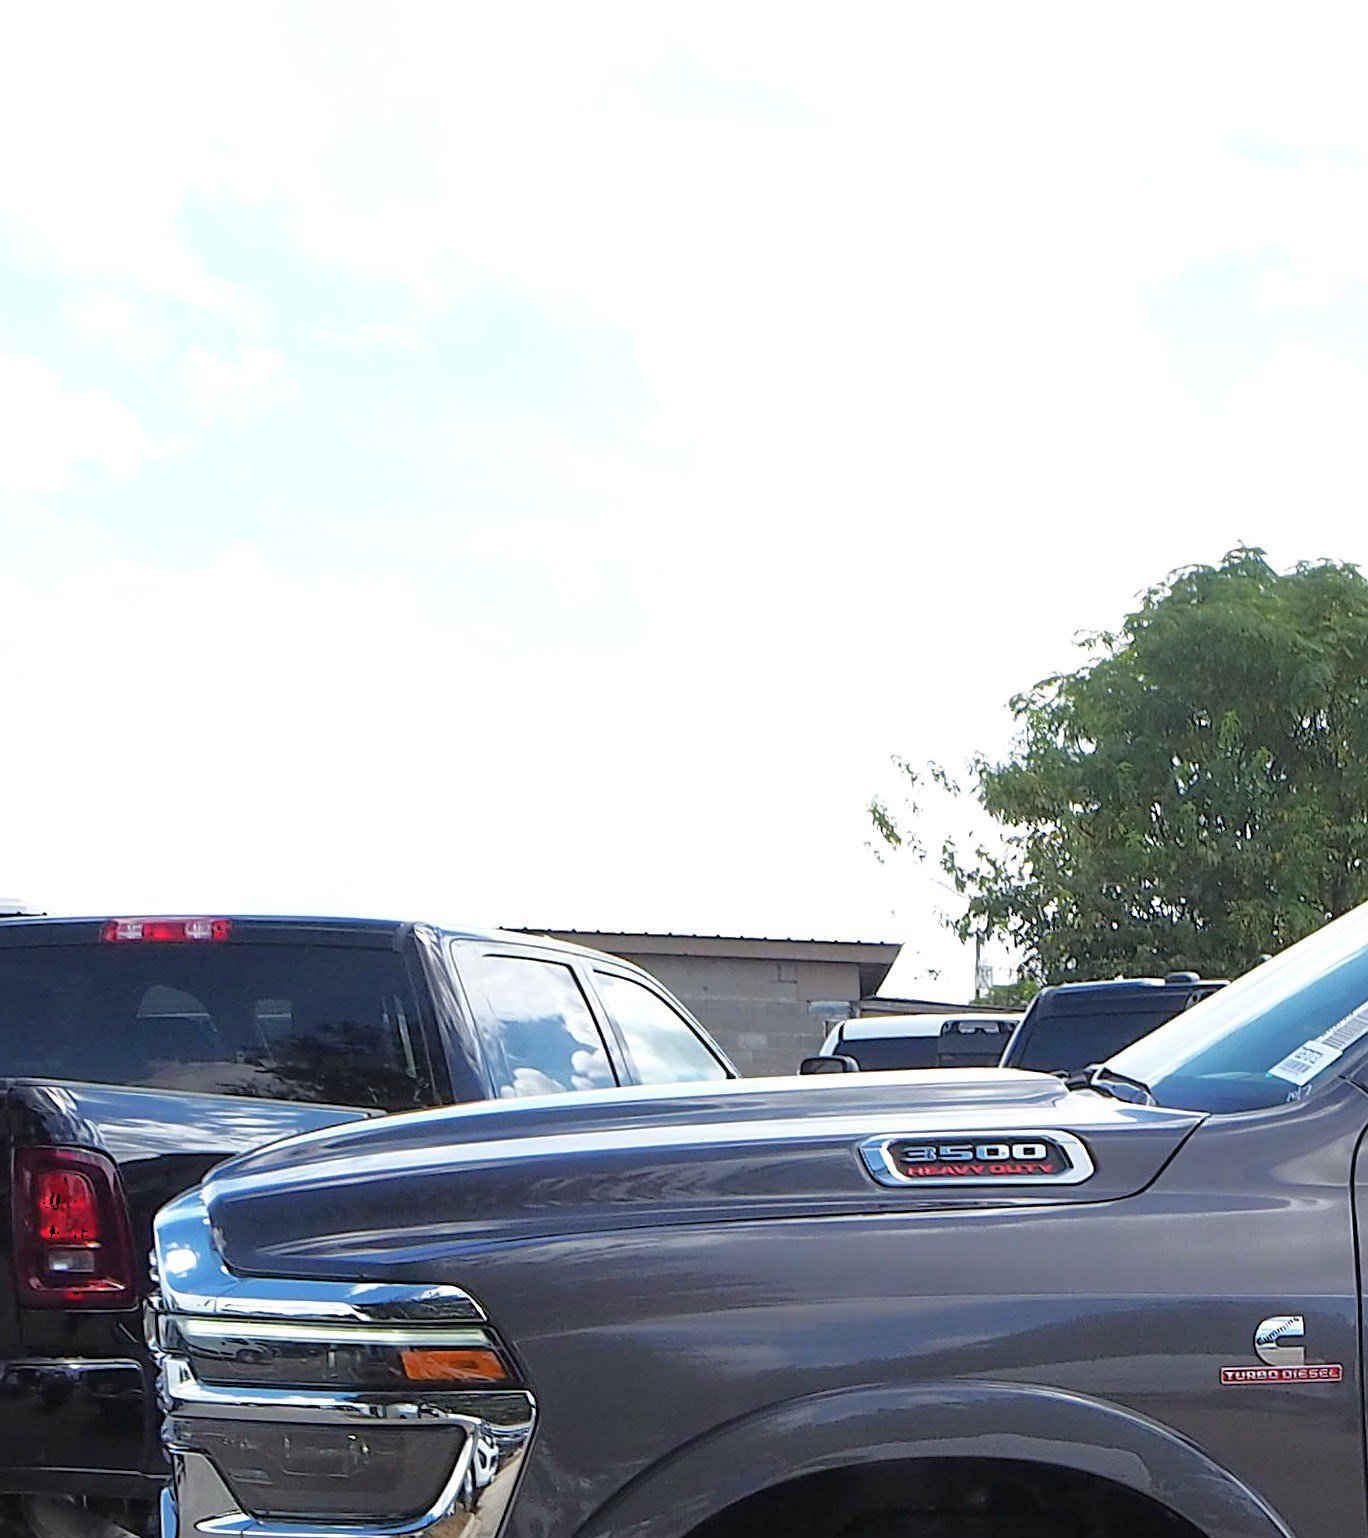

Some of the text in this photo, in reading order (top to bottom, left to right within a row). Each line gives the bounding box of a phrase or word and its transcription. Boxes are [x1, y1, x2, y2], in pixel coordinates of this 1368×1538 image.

[901, 1142, 1047, 1162] 3500
[905, 1164, 1053, 1177] HEAVY DUTY
[1224, 1368, 1339, 1381] TURBO DIESEL
